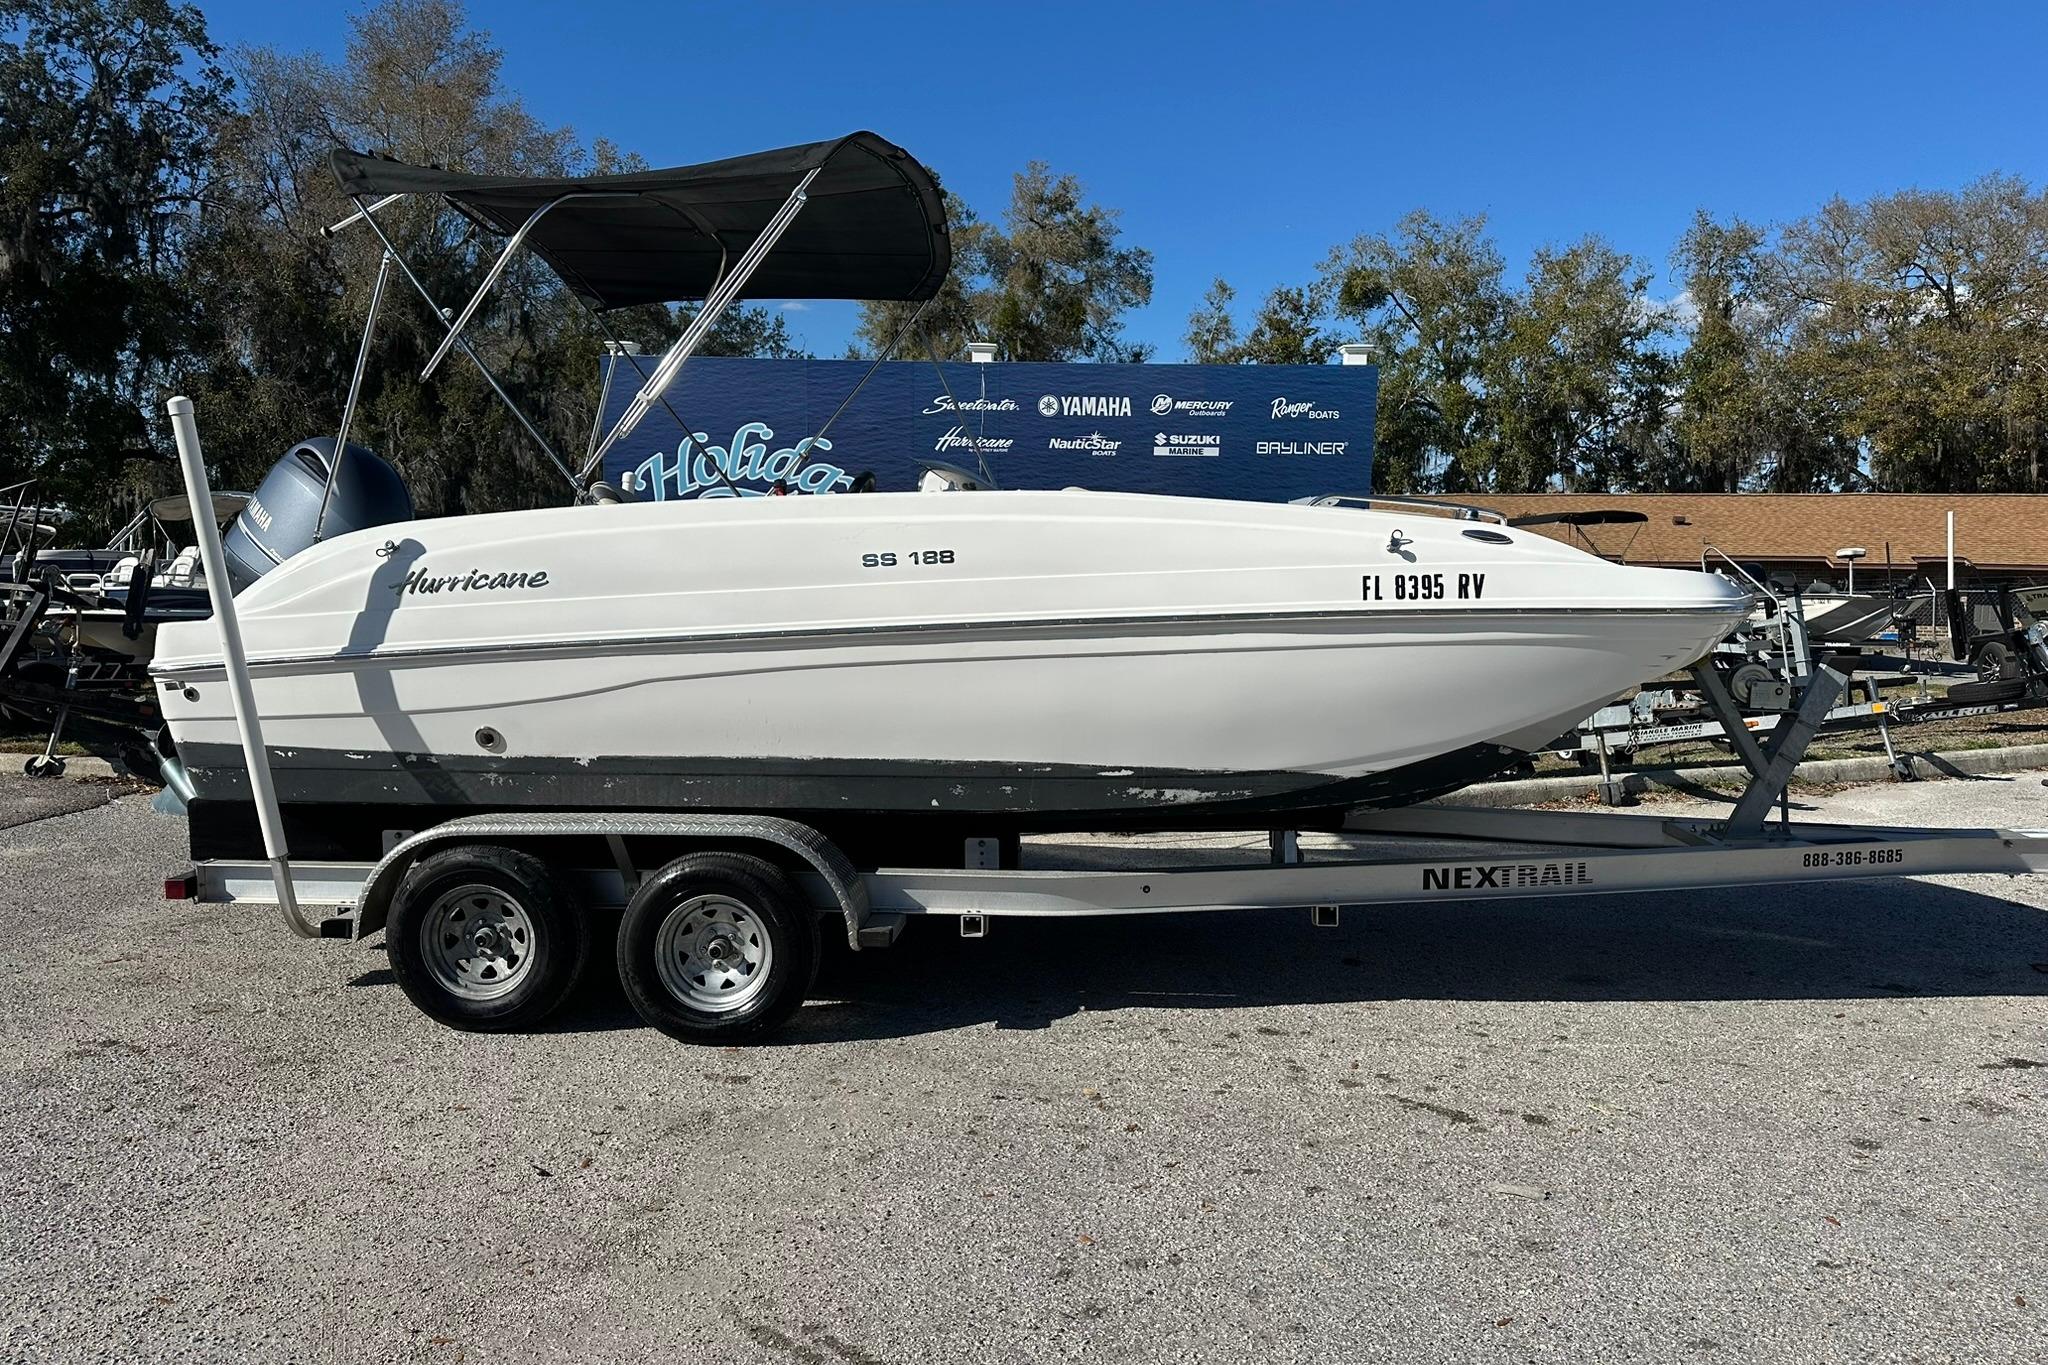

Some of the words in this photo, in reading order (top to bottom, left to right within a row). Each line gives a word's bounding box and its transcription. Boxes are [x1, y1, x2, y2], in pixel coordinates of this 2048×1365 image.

[1061, 396, 1132, 417] YAMAHA
[1174, 400, 1234, 410] MERCURY
[1188, 409, 1226, 417] Outboards
[1270, 397, 1312, 420] Ranger
[1308, 411, 1340, 419] BOATS
[934, 425, 1014, 452] Hurricane
[1049, 437, 1122, 451] NauticStar
[1169, 435, 1221, 445] SUZUKI
[1168, 447, 1205, 456] MARINE
[1256, 442, 1345, 455] BAYLINER
[634, 422, 856, 501] Holida
[862, 552, 898, 568] SS
[908, 549, 955, 565] 188
[388, 566, 550, 596] Hurricane
[1362, 575, 1384, 601] FL
[1394, 573, 1445, 601] 8395
[1457, 573, 1486, 600] RV
[1632, 727, 1669, 737] RIANGLE
[1670, 724, 1703, 732] MARINE
[1803, 848, 1903, 868] 888-386-8685
[1422, 862, 1594, 891] NEXTRAIL
